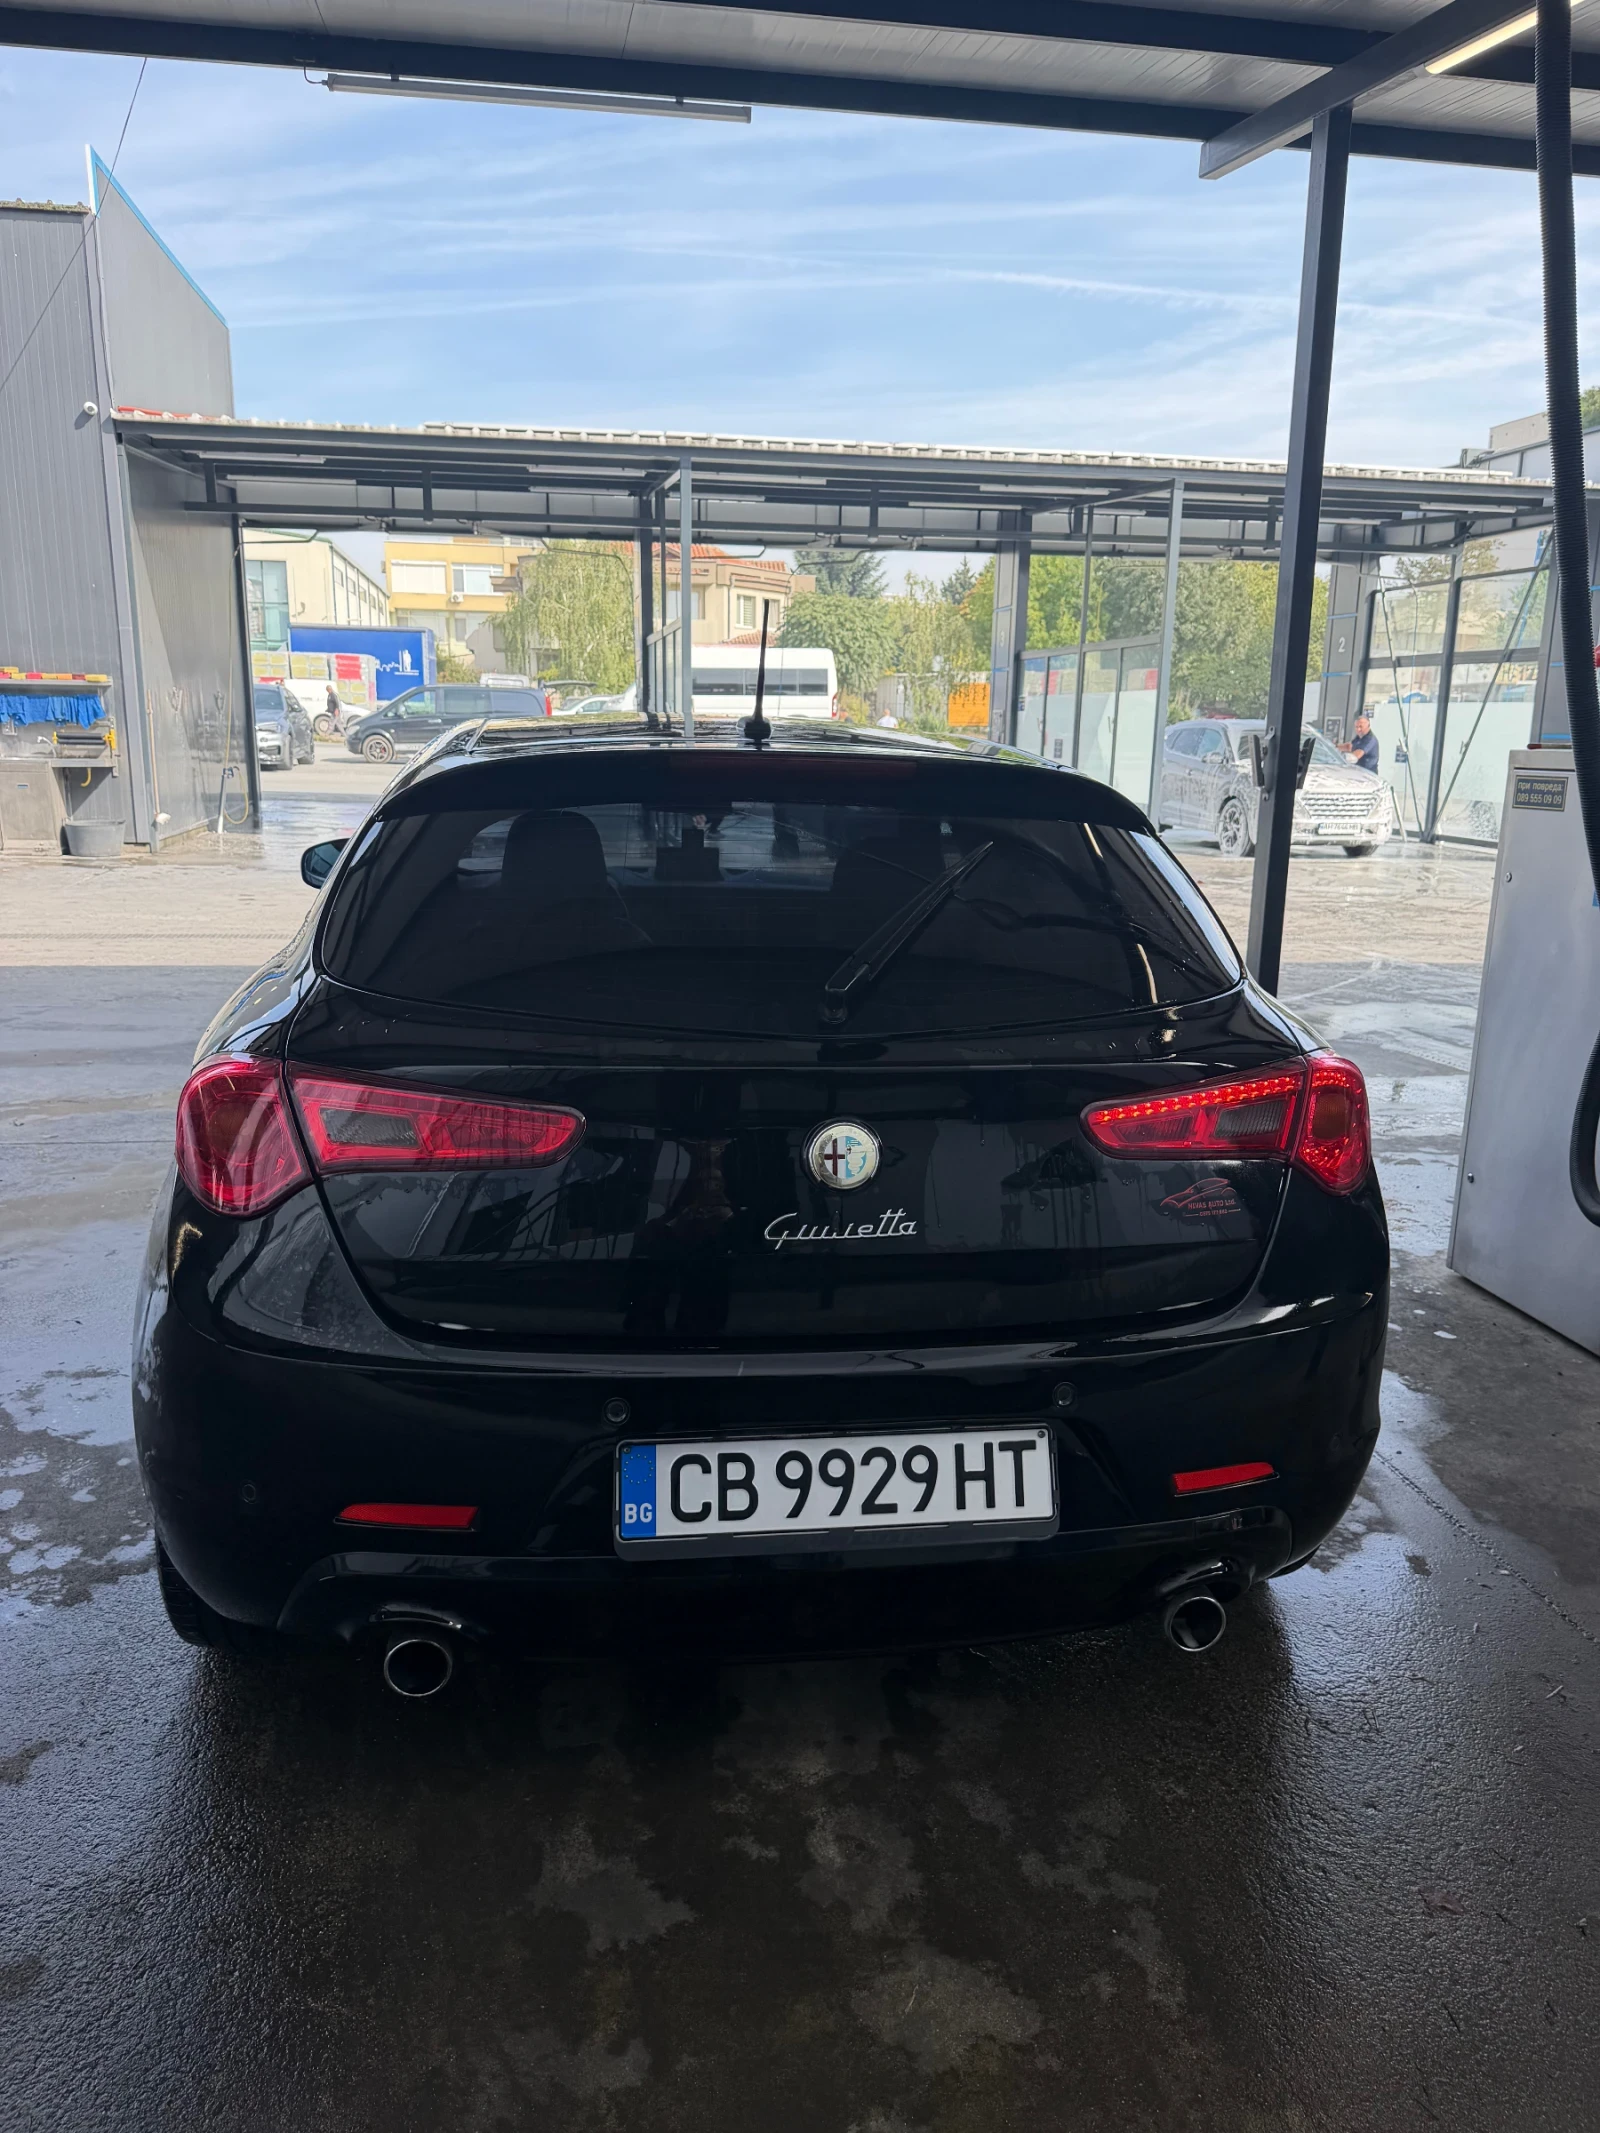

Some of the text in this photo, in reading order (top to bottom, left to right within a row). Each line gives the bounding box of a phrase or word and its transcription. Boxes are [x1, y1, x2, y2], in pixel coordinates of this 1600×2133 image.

[1338, 636, 1346, 652] 2
[1518, 782, 1531, 791] при
[1517, 793, 1562, 804] 089 555 09 09
[1208, 1200, 1224, 1208] AUTO
[764, 1208, 917, 1250] Giulietta
[670, 1440, 1037, 1523] CB 9929 HT
[624, 1502, 653, 1524] BG
